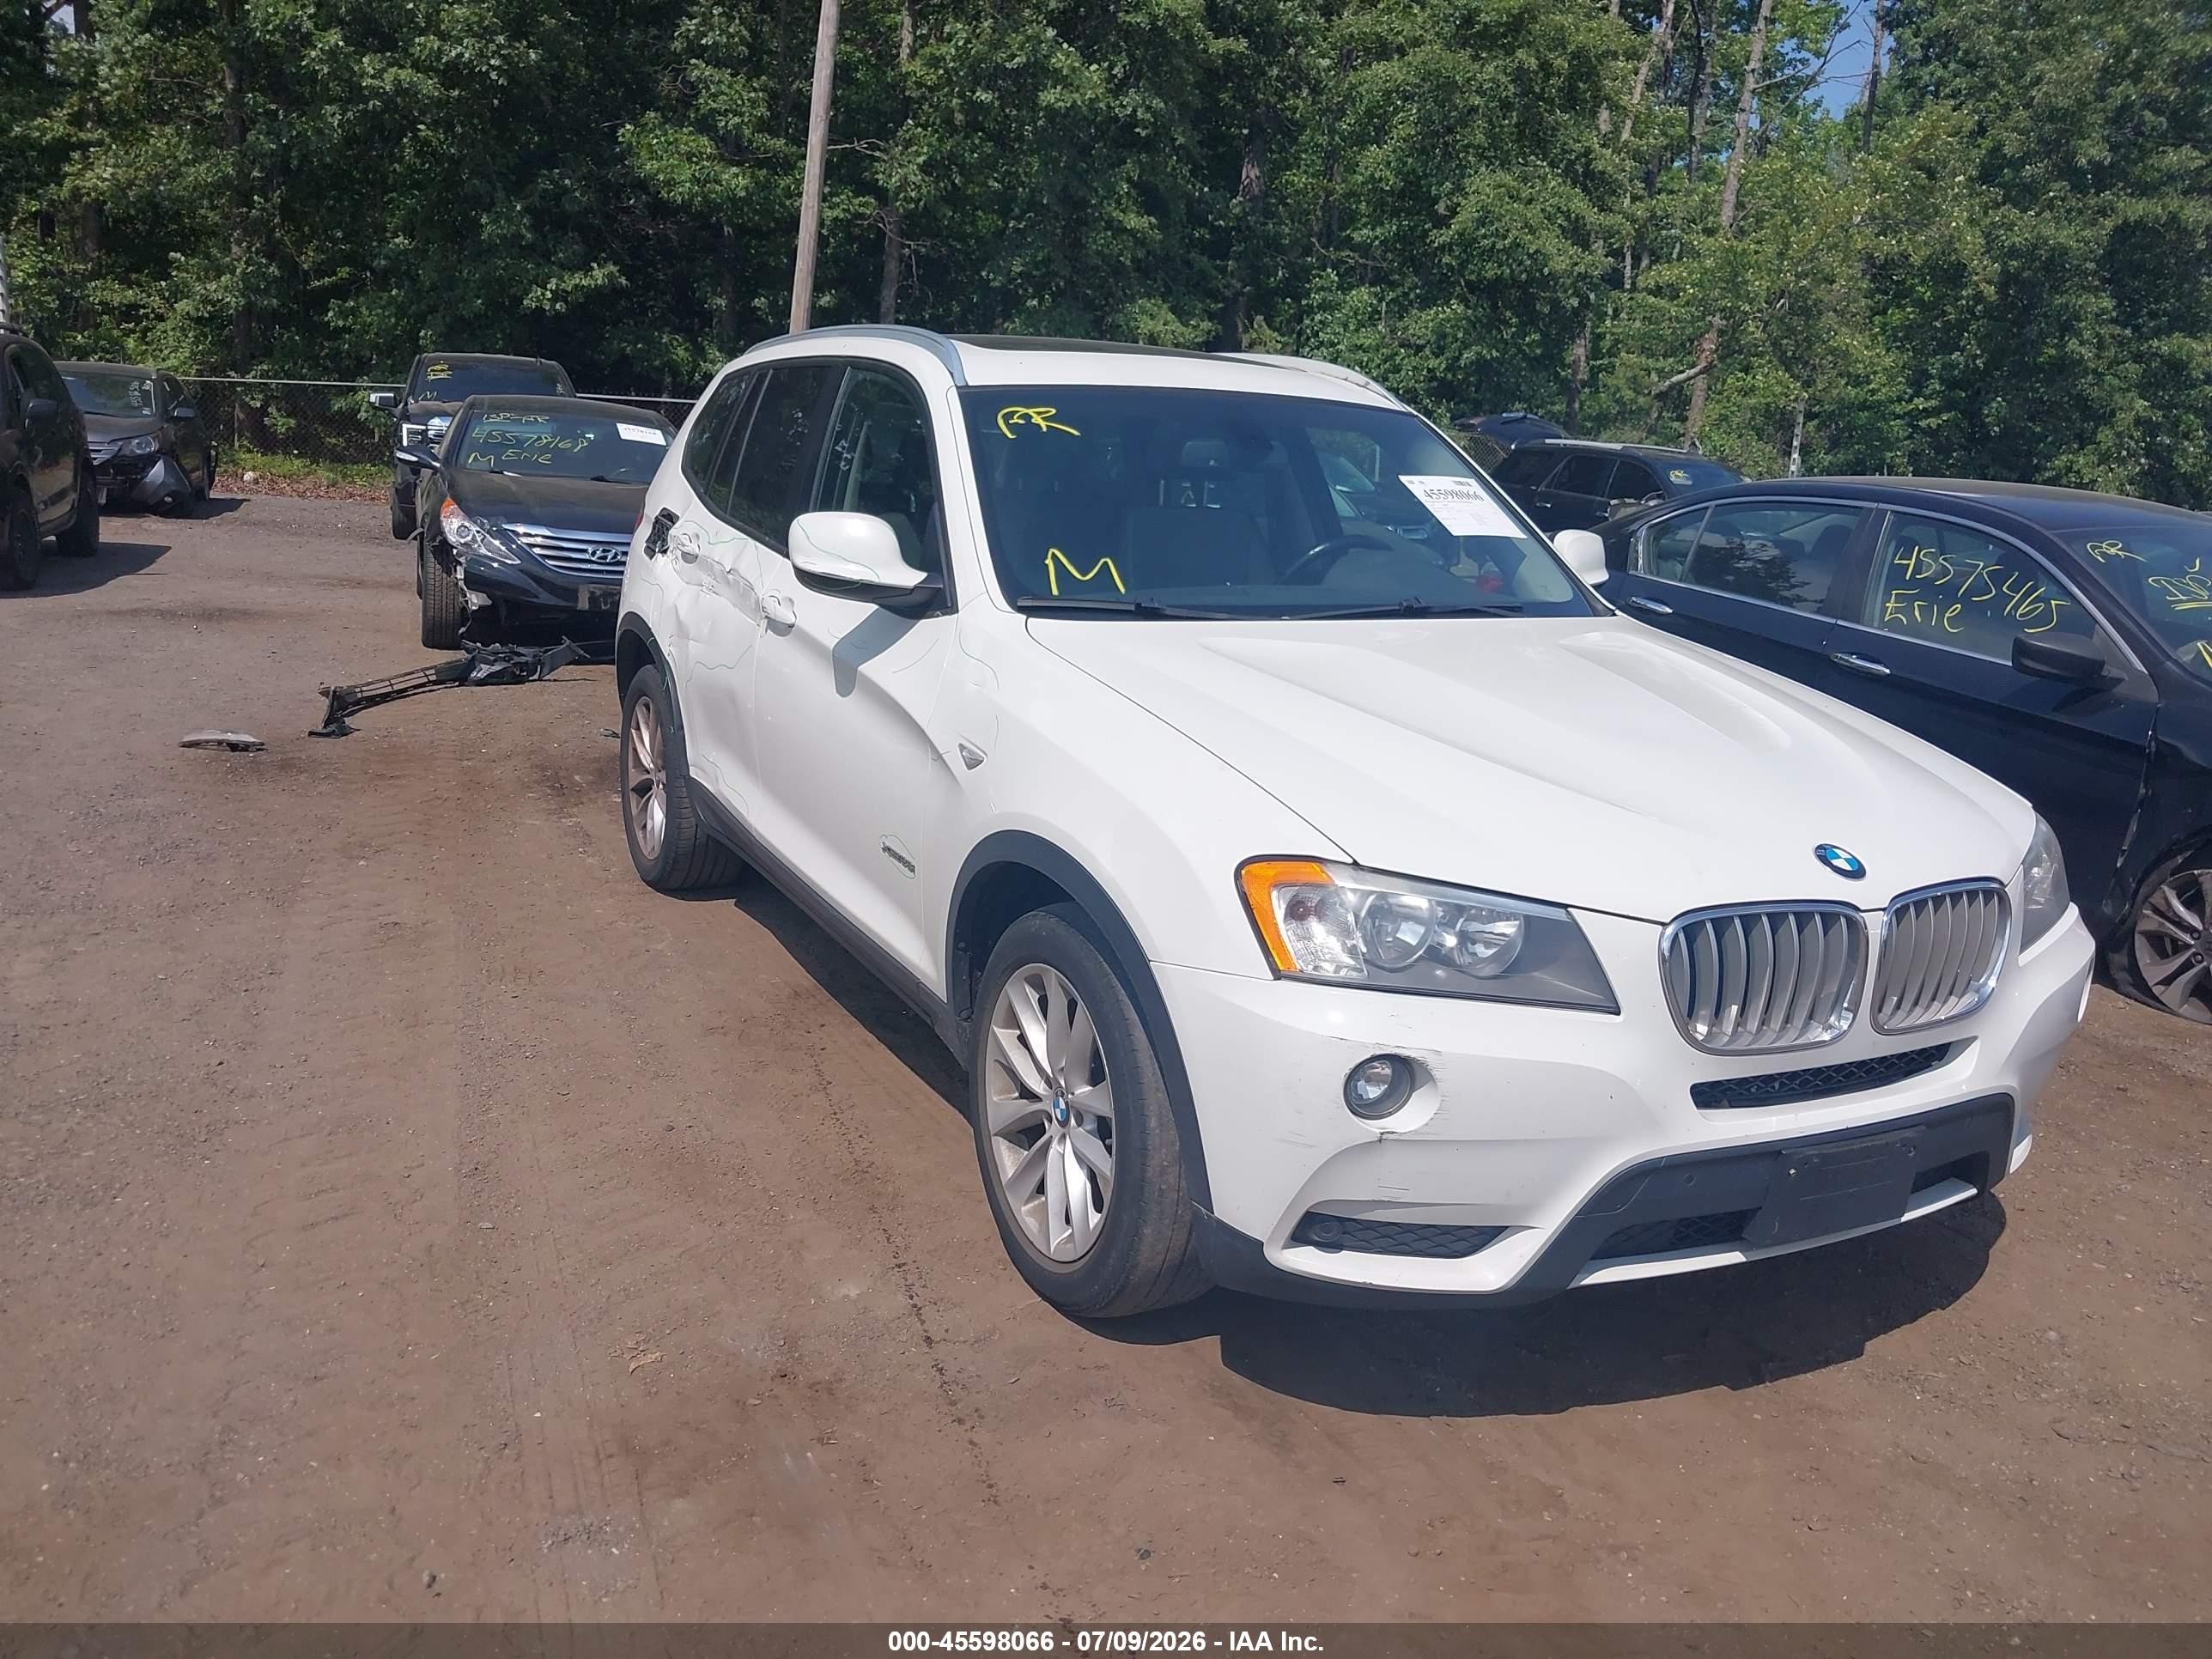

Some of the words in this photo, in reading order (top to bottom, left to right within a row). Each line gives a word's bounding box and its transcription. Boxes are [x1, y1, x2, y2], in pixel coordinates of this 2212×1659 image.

[471, 427, 589, 453] 45578168
[467, 452, 495, 468] M
[501, 449, 553, 465] Erie
[1423, 489, 1485, 502] 45598066
[1043, 547, 1127, 596] M
[1893, 544, 2072, 634] 45575465
[1884, 588, 1966, 633] Erie
